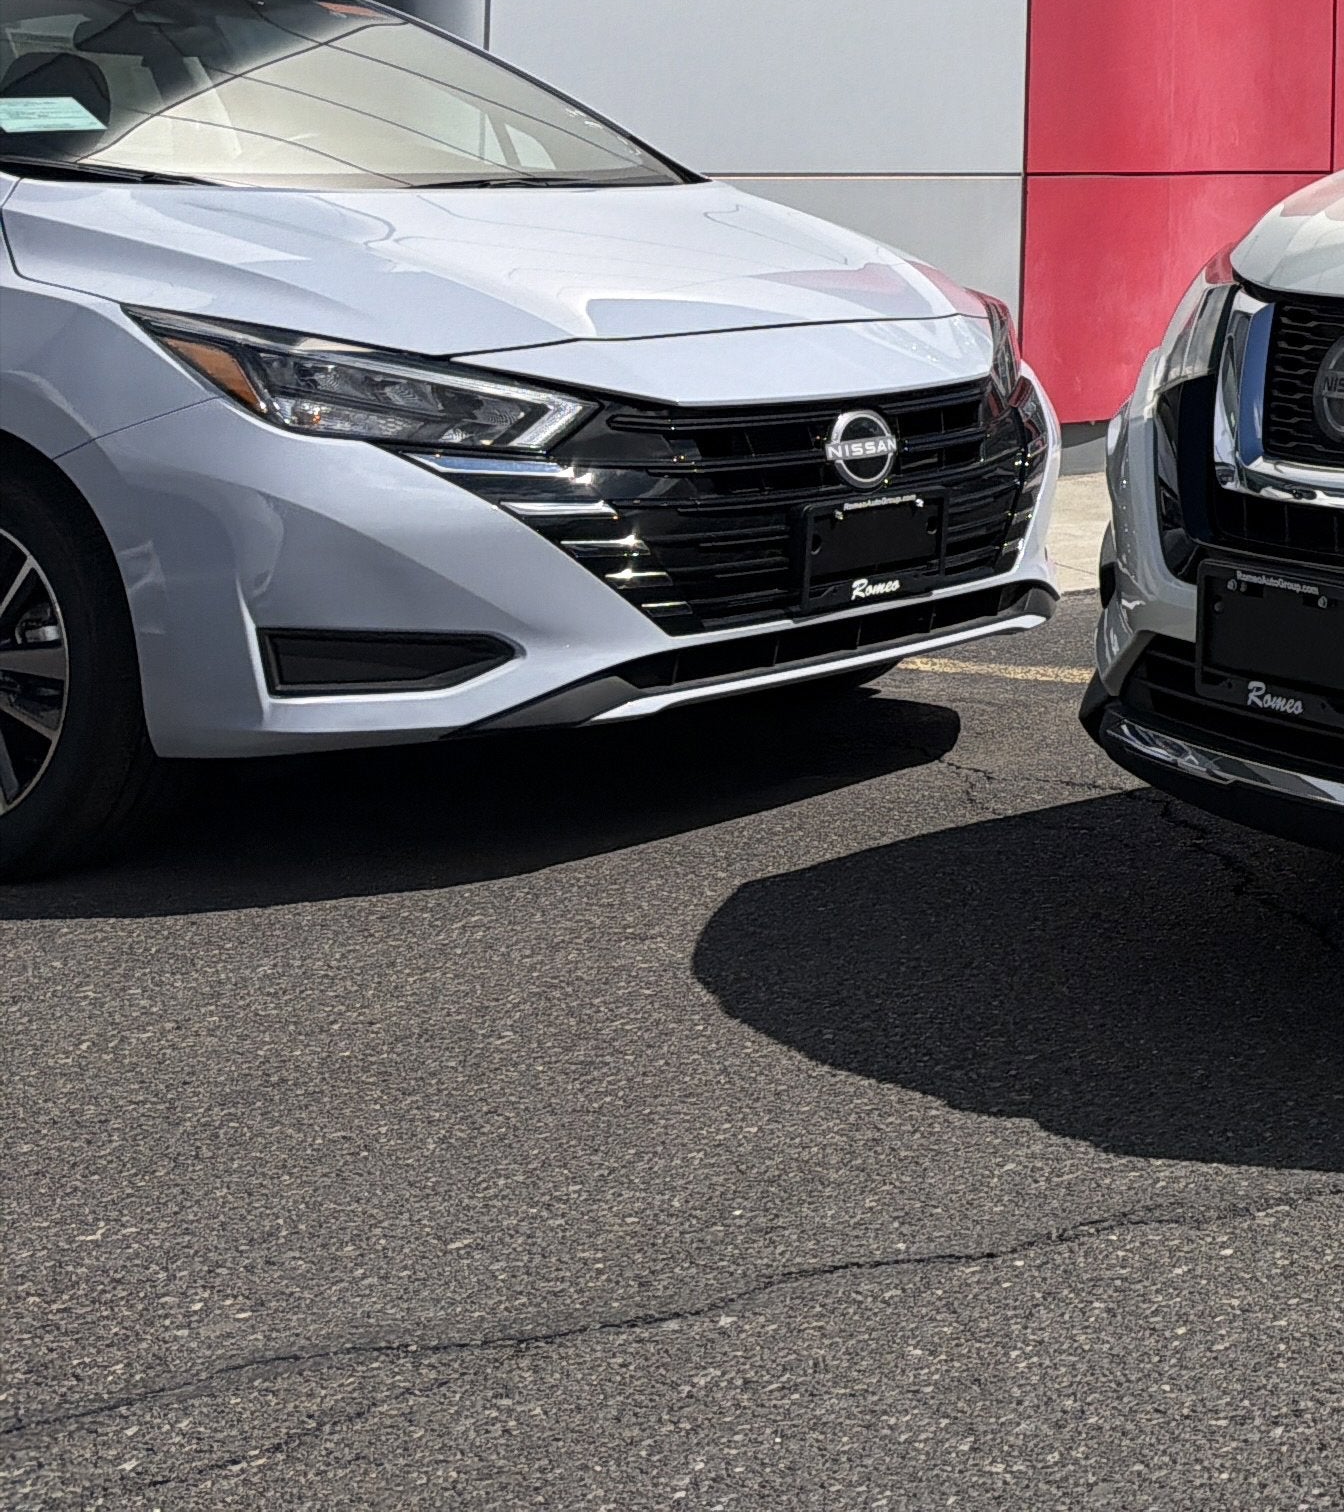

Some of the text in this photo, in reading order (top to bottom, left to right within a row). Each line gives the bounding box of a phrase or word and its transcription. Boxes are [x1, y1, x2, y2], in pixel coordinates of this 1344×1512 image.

[827, 438, 897, 458] NISSAN
[851, 578, 900, 600] Romeo
[1236, 570, 1319, 595] RomeoAutoGroup.com
[1247, 680, 1303, 715] Romeo
